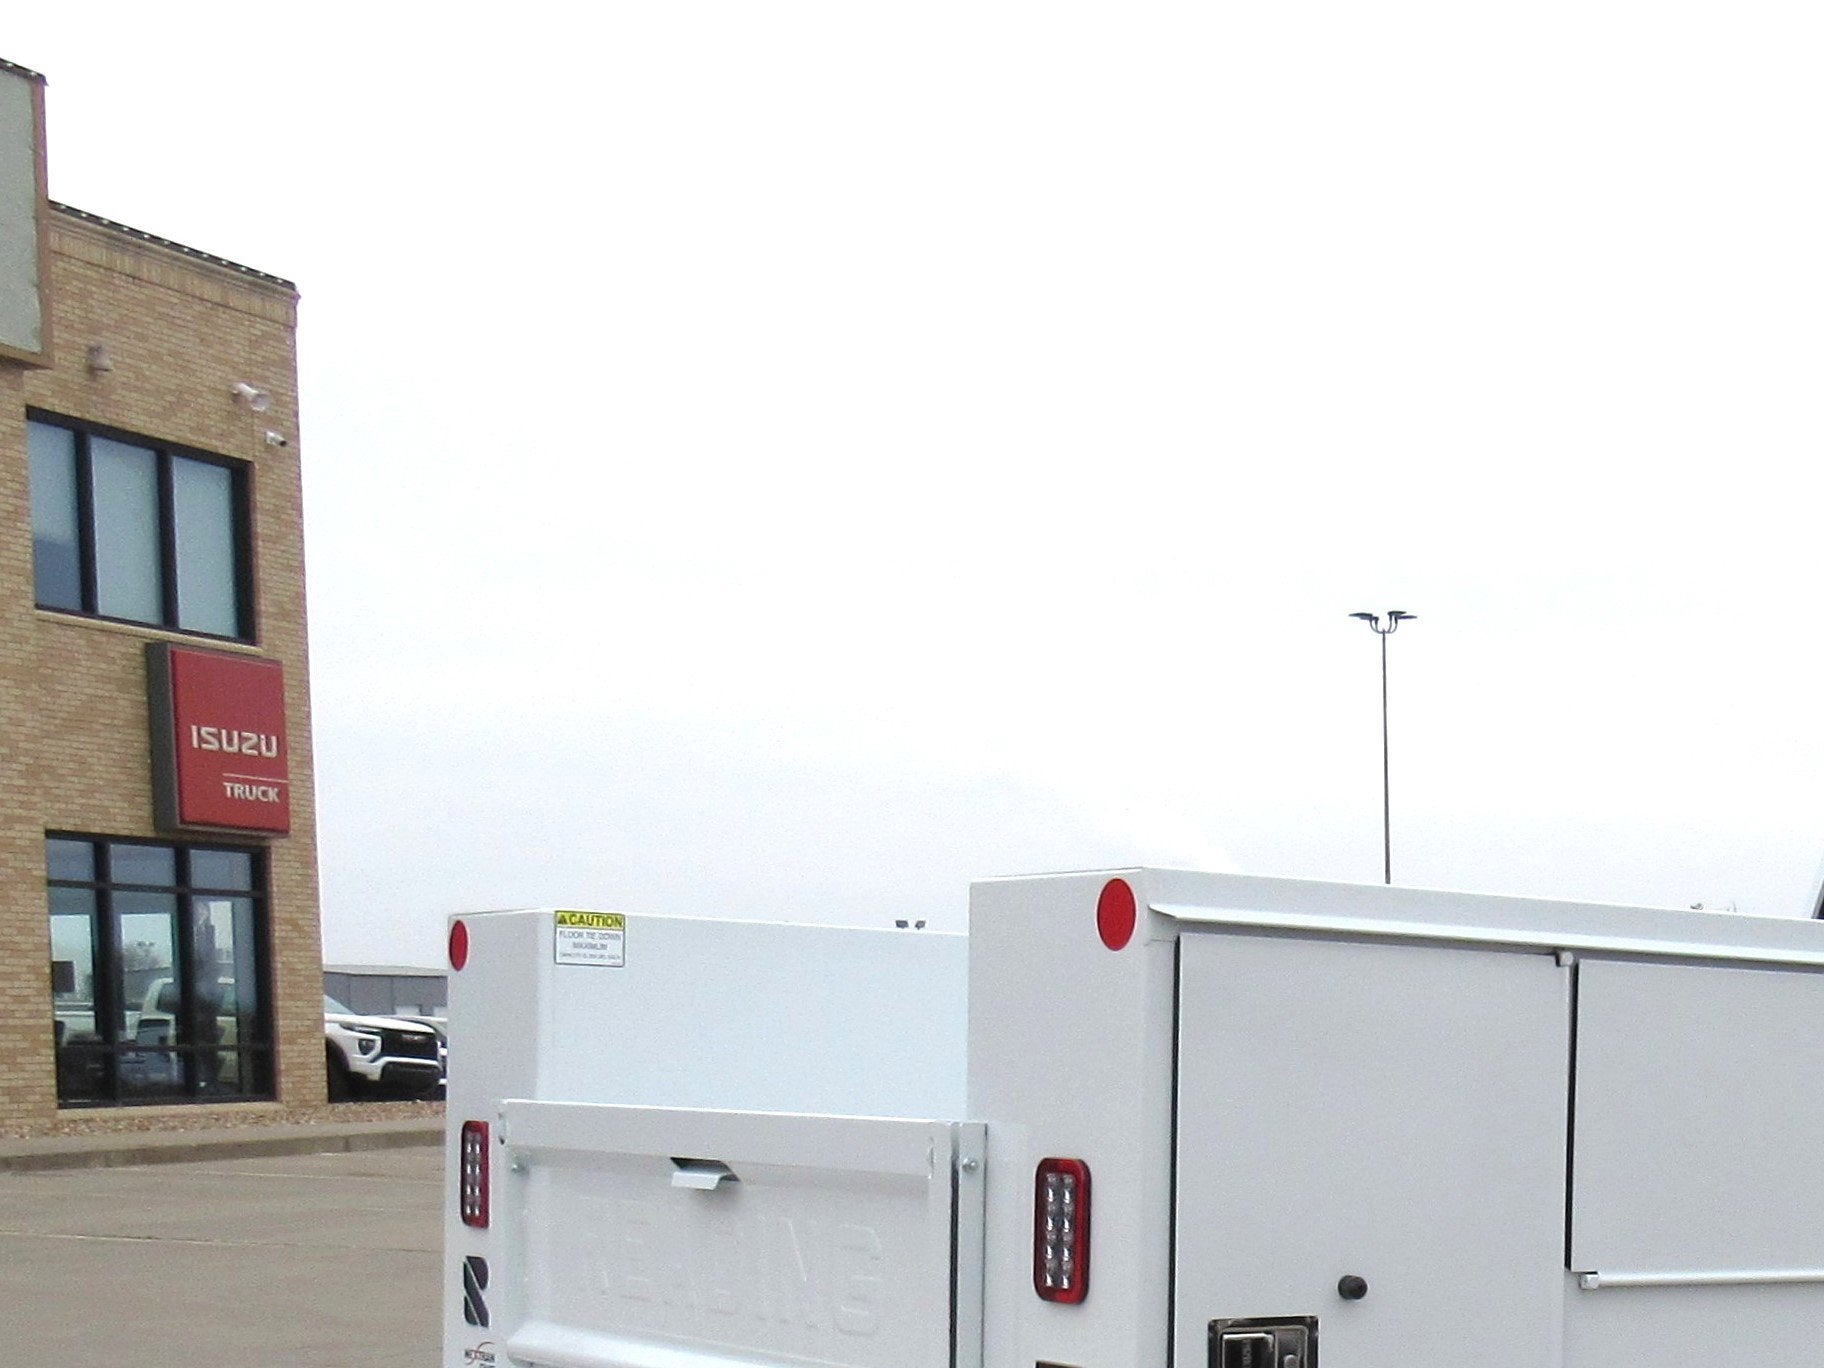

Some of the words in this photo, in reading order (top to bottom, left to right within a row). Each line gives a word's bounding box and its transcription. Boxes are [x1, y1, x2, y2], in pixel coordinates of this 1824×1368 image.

[190, 725, 278, 758] ISUZU
[223, 781, 280, 802] TRUCK
[569, 914, 623, 928] CAUTION
